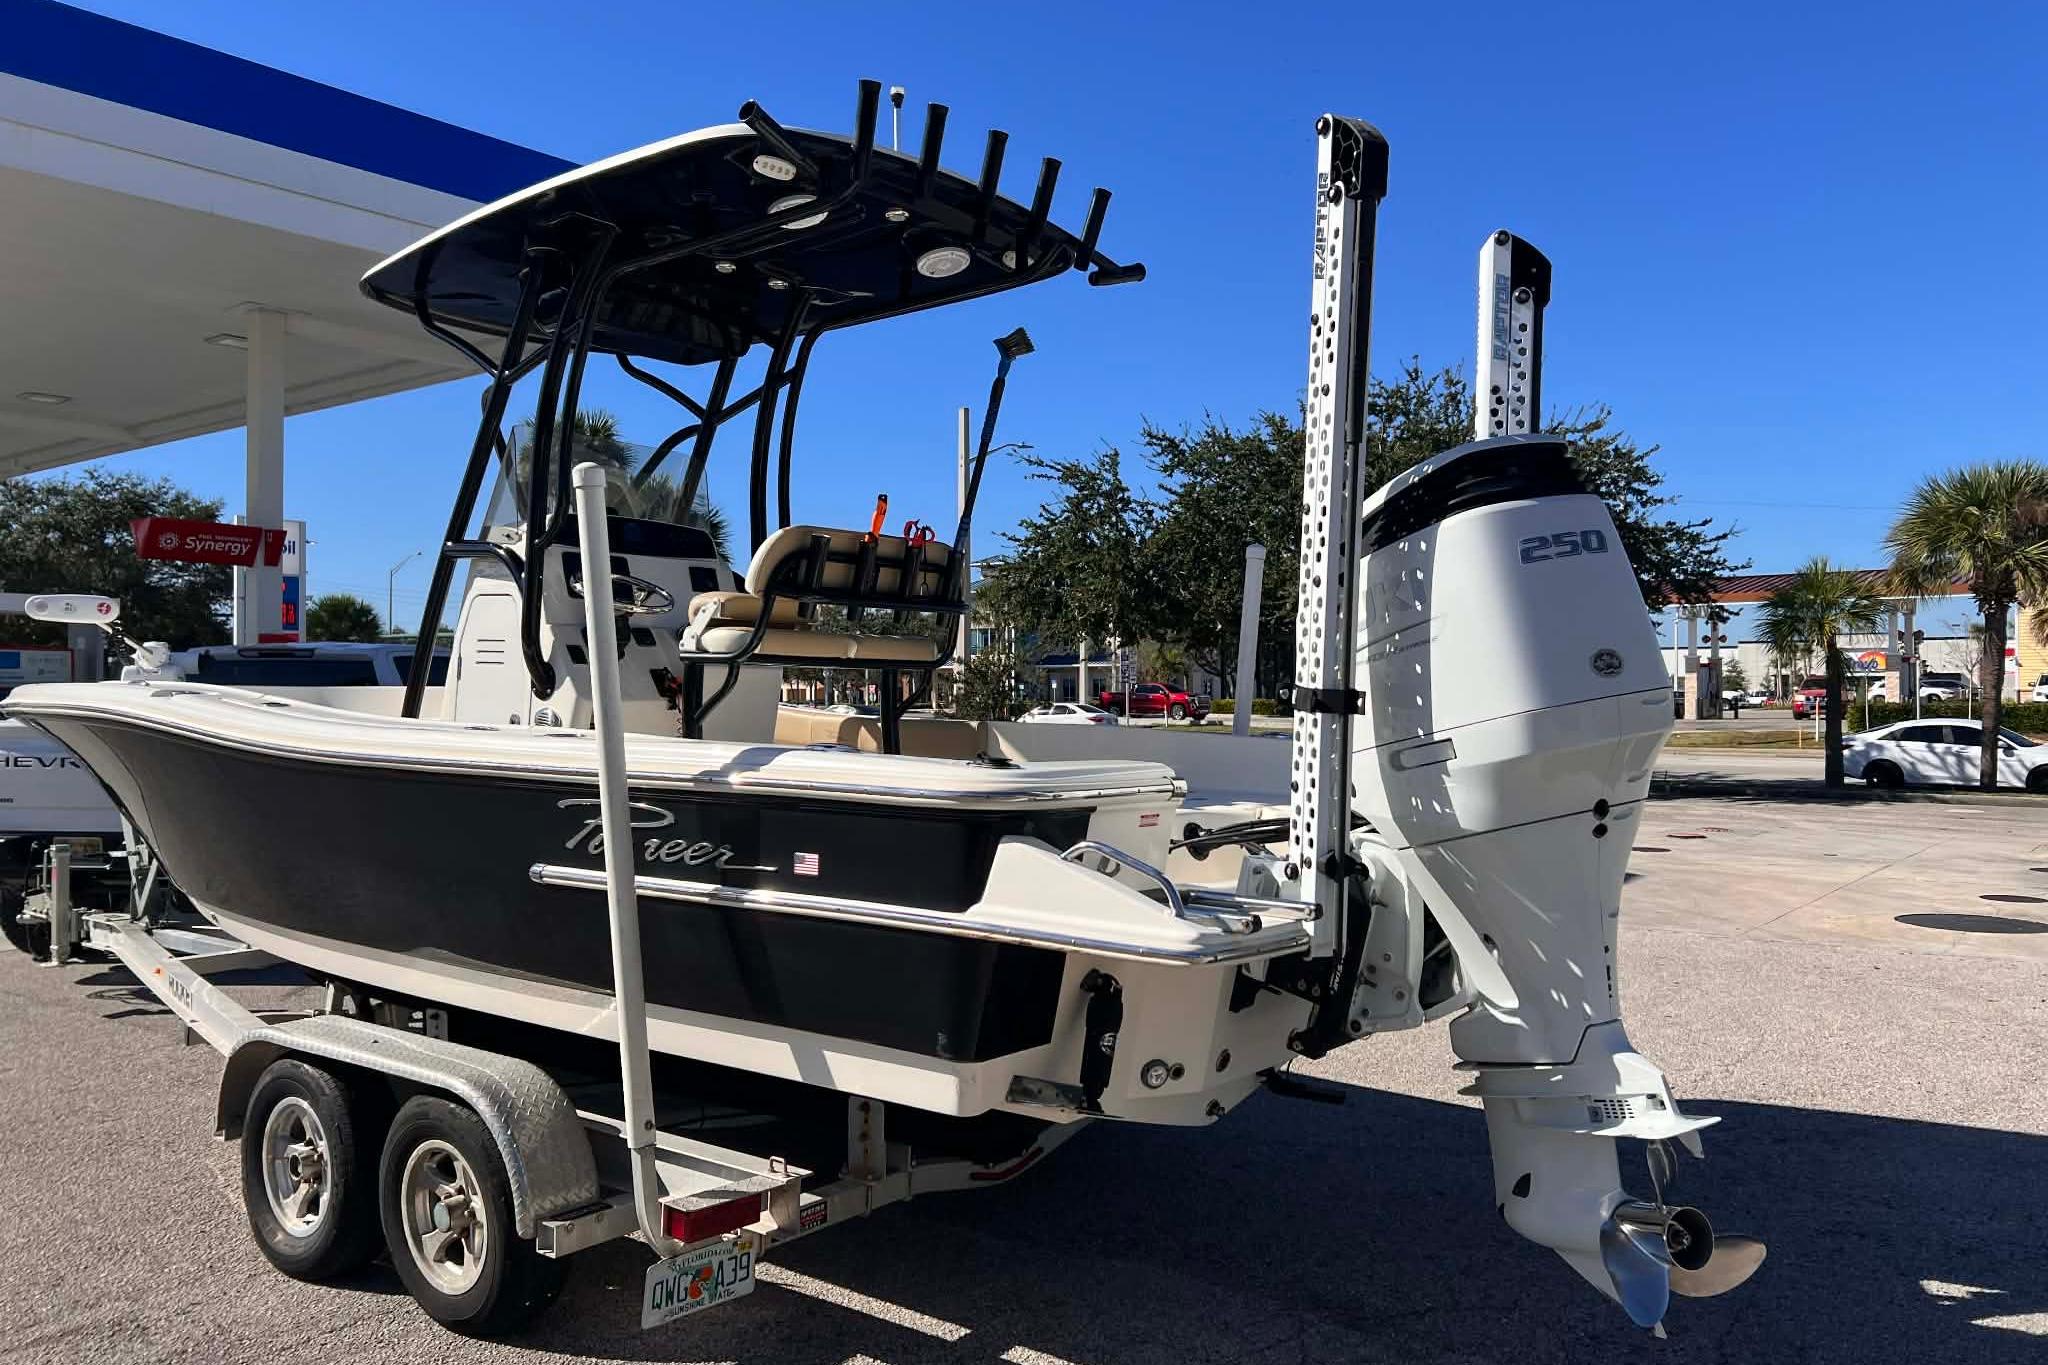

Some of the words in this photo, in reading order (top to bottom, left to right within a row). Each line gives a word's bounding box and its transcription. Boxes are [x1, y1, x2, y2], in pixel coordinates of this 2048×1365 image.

[1314, 172, 1329, 279] RAPTOR
[1493, 273, 1510, 361] RAPTOR
[184, 536, 250, 556] Synergy
[1519, 529, 1608, 565] 250
[652, 1272, 693, 1311] QWG
[714, 1252, 751, 1291] A39
